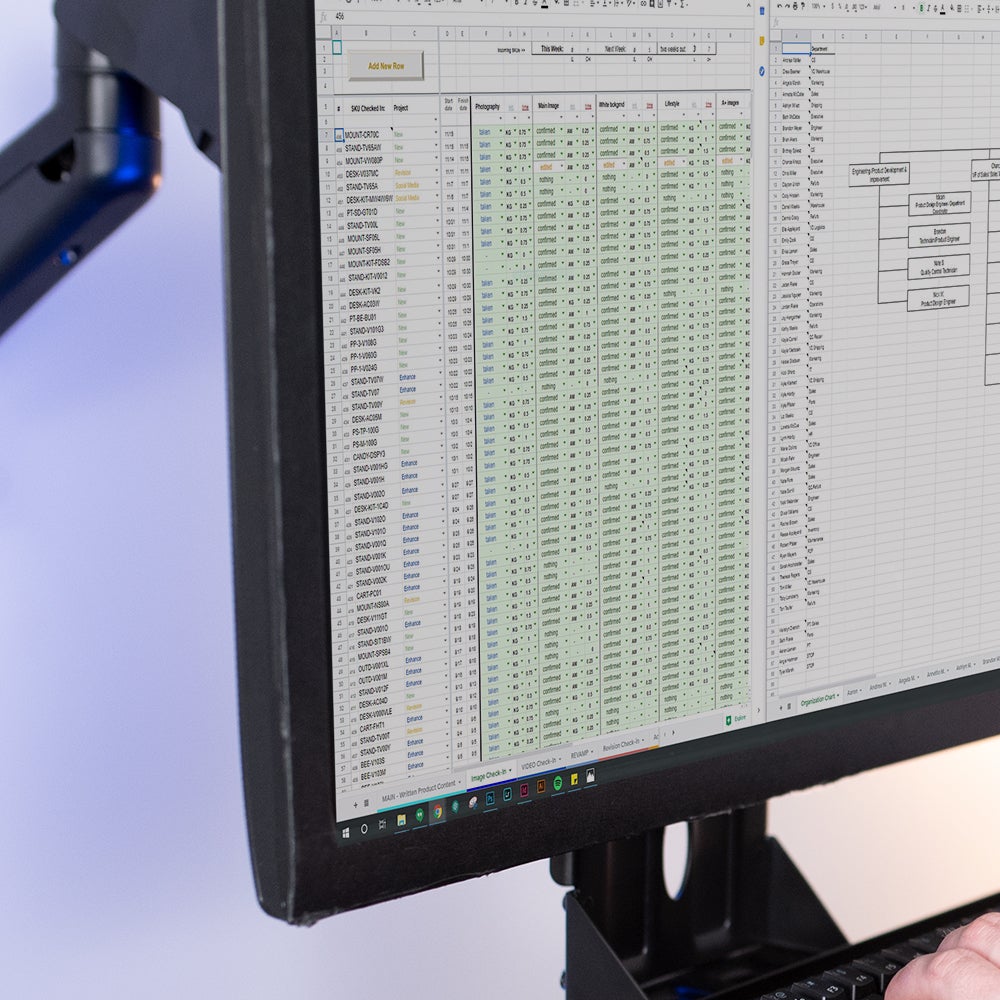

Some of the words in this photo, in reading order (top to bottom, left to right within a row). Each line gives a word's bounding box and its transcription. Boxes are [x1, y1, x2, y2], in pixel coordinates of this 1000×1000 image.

[335, 12, 345, 21] 456
[801, 695, 824, 707] Organization
[603, 742, 620, 752] Revision
[571, 750, 589, 759] REVAMP
[521, 762, 536, 770] VIDEO
[472, 774, 485, 782] Image
[486, 769, 506, 778] Check-In
[382, 794, 396, 802] MAIN
[418, 785, 436, 794] Product
[437, 780, 455, 789] Content
[827, 985, 839, 994] F3
